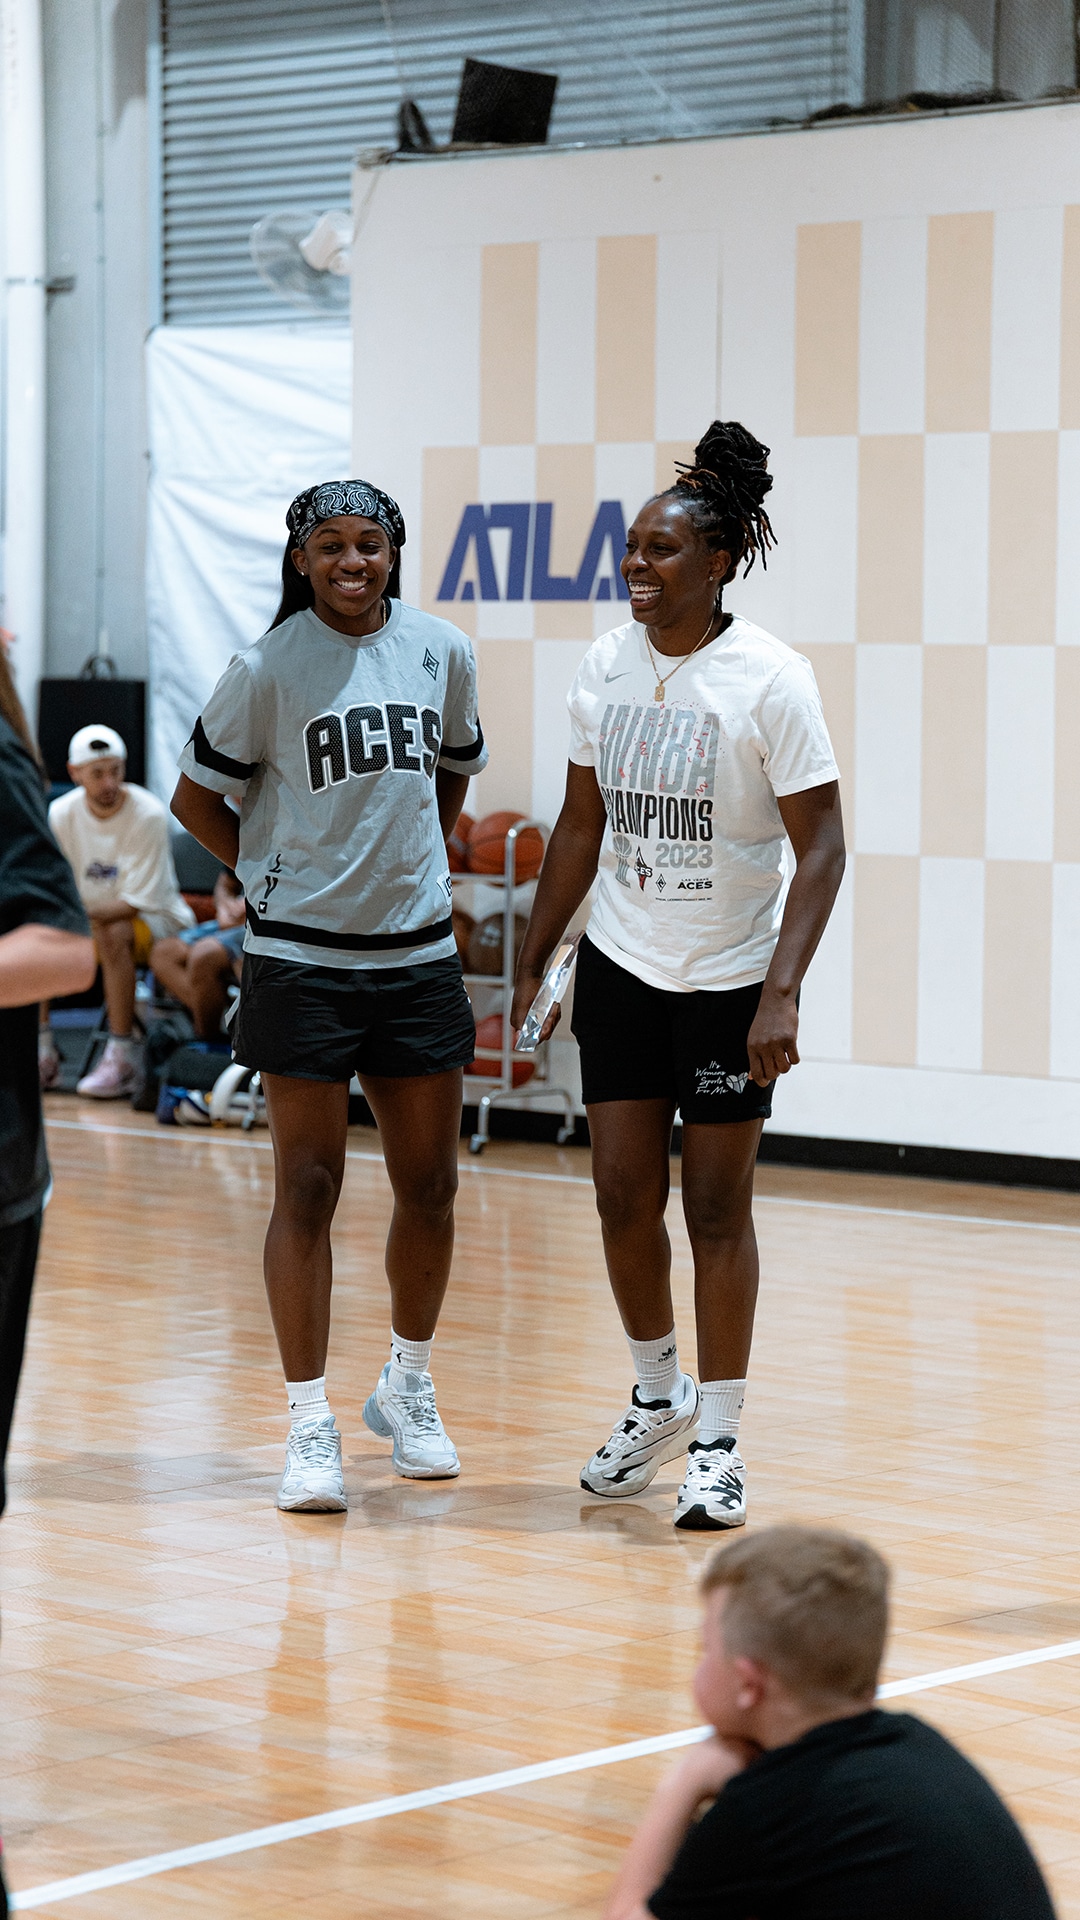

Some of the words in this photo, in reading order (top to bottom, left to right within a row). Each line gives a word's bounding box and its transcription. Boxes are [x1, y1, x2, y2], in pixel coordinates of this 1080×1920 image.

[303, 701, 442, 794] ACES
[599, 704, 719, 797] WNBA
[601, 786, 713, 842] AMPIONS
[655, 842, 713, 869] 2023
[677, 880, 713, 890] ACES
[710, 1086, 729, 1095] Me
